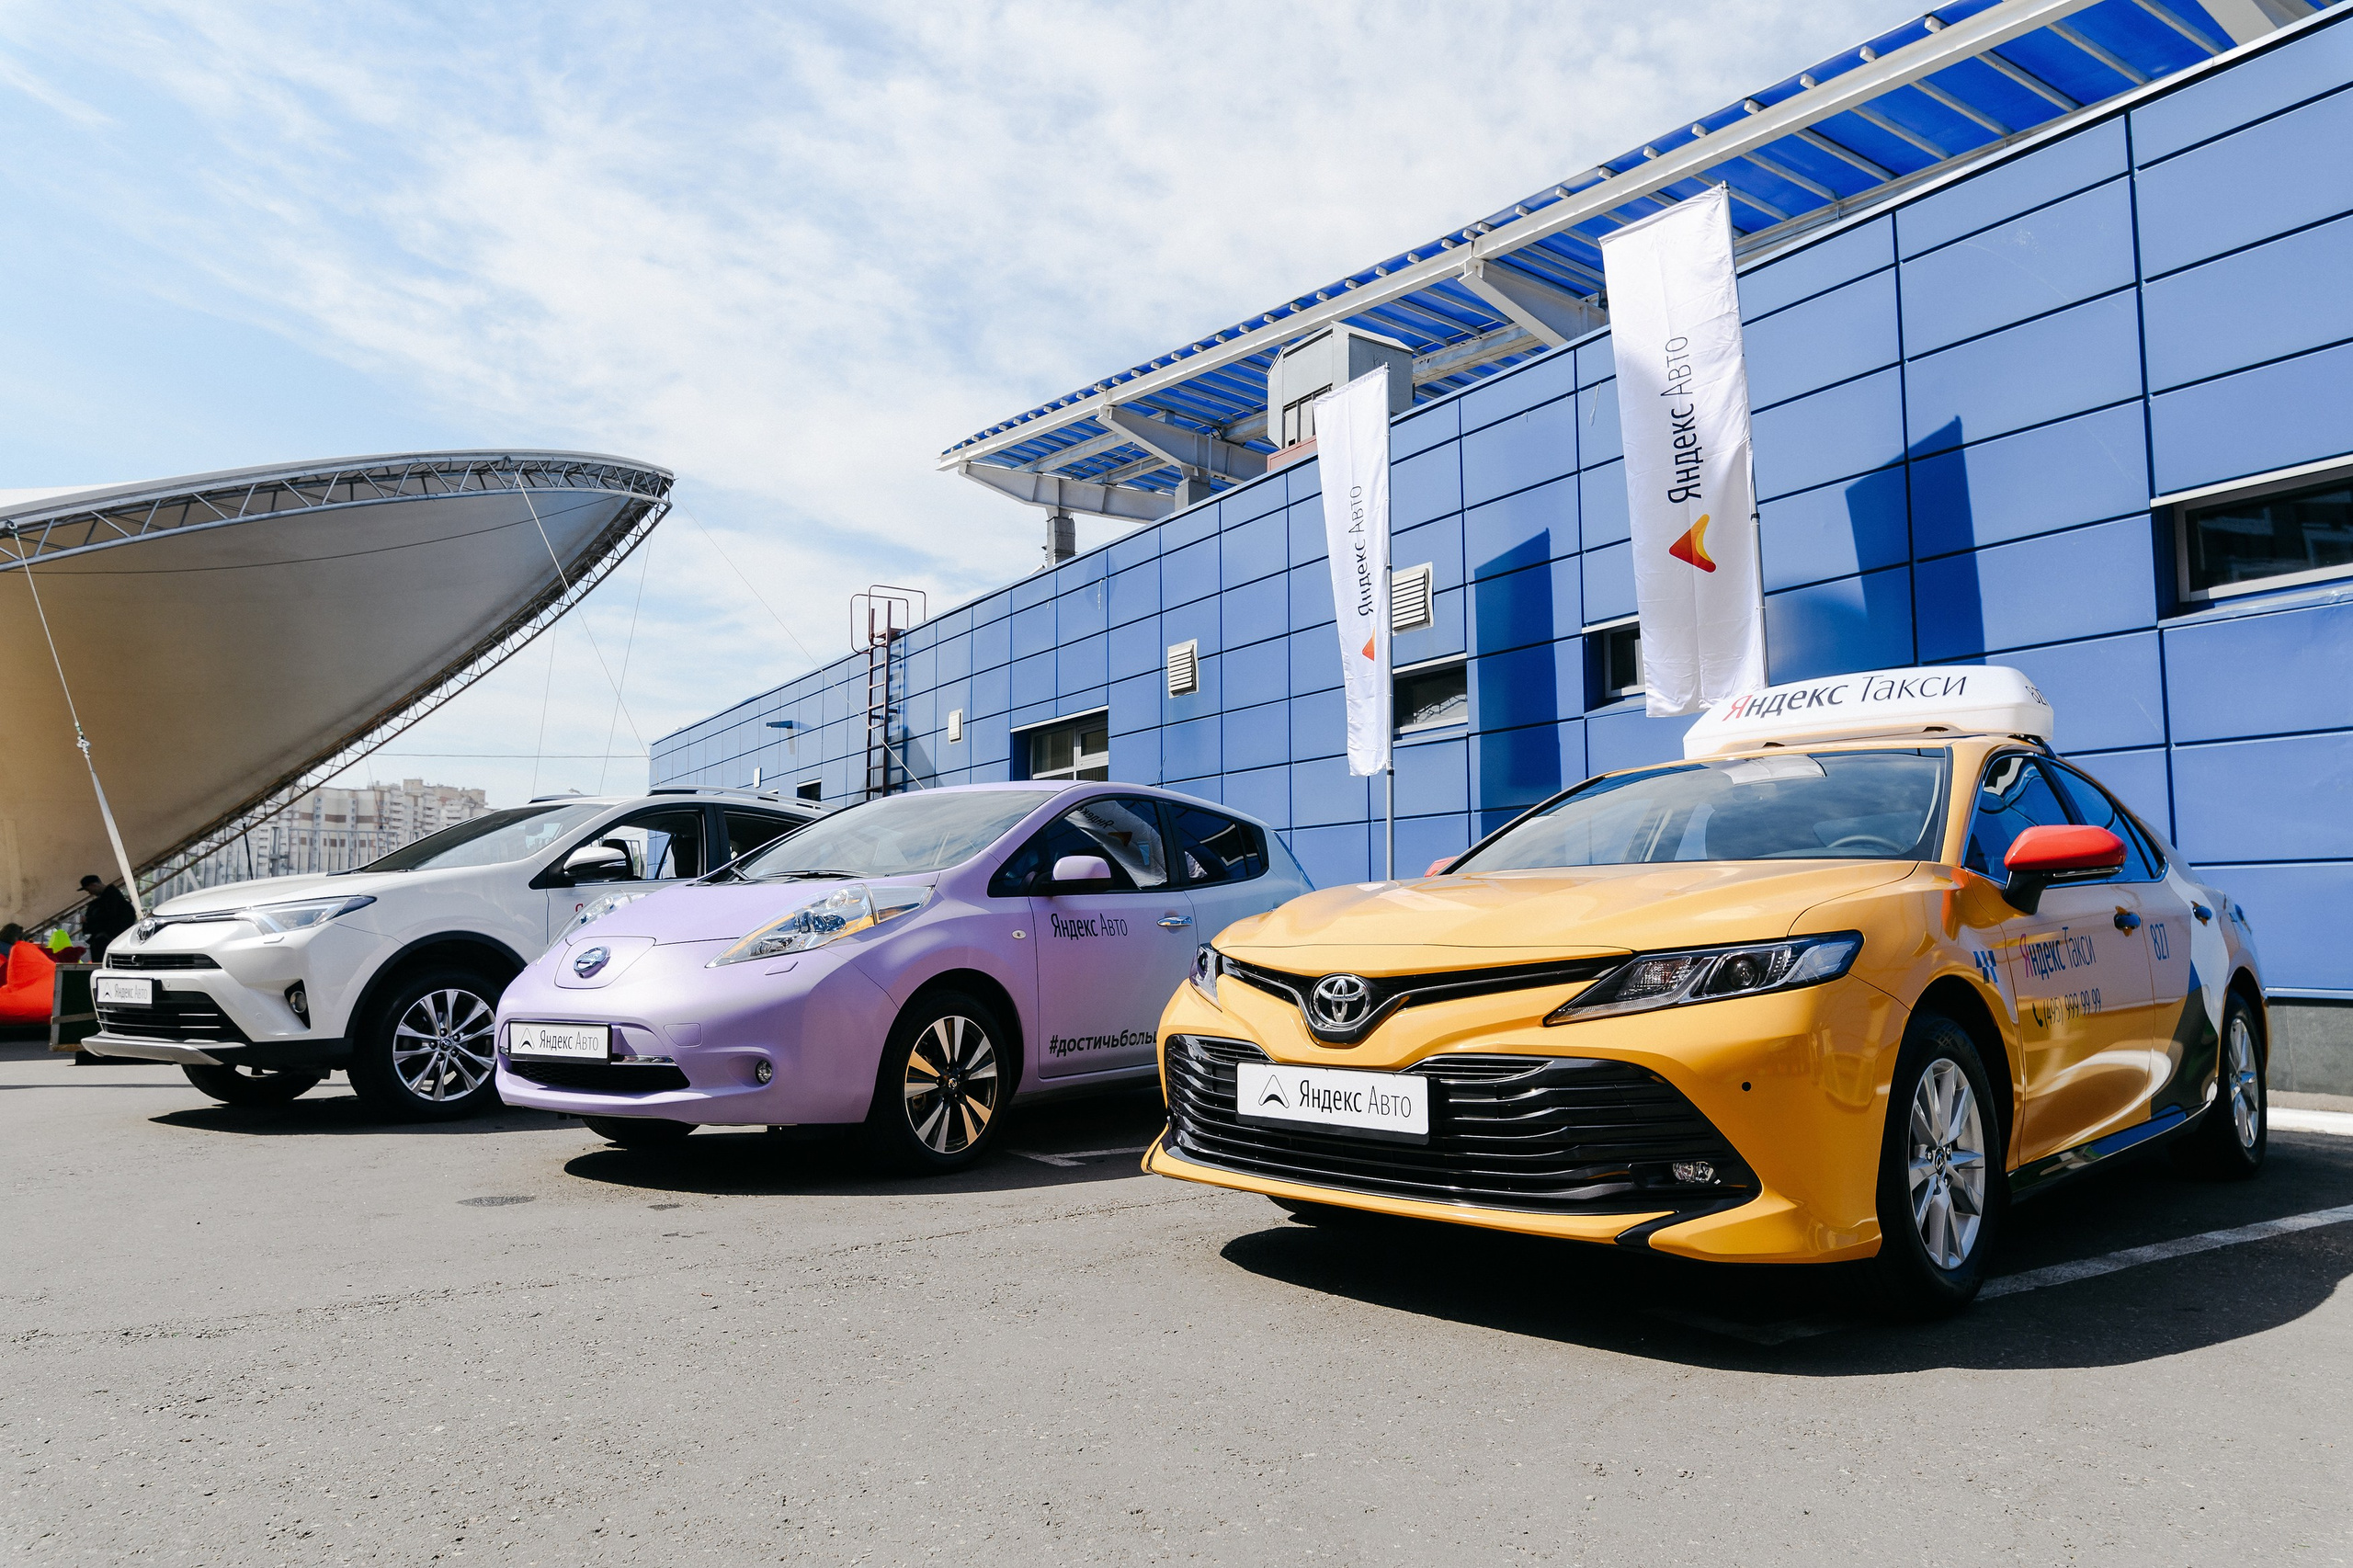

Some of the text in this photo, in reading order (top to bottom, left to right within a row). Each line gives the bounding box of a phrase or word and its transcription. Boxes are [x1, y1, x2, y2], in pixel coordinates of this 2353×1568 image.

[1660, 336, 1703, 504] Яндекс Авто
[1354, 539, 1374, 617] Яндекс
[1722, 674, 1968, 722] Яндекс Такси
[1051, 912, 1128, 940] Яндекс Авто
[2150, 923, 2170, 960] 827
[2019, 926, 2097, 980] Яндекс Такси
[114, 983, 133, 1000] Яндекс
[2043, 987, 2101, 1029] (495) 999 99 99
[540, 1029, 598, 1051] Яндекс Авто
[1299, 1079, 1412, 1118] Яндекс Авто
